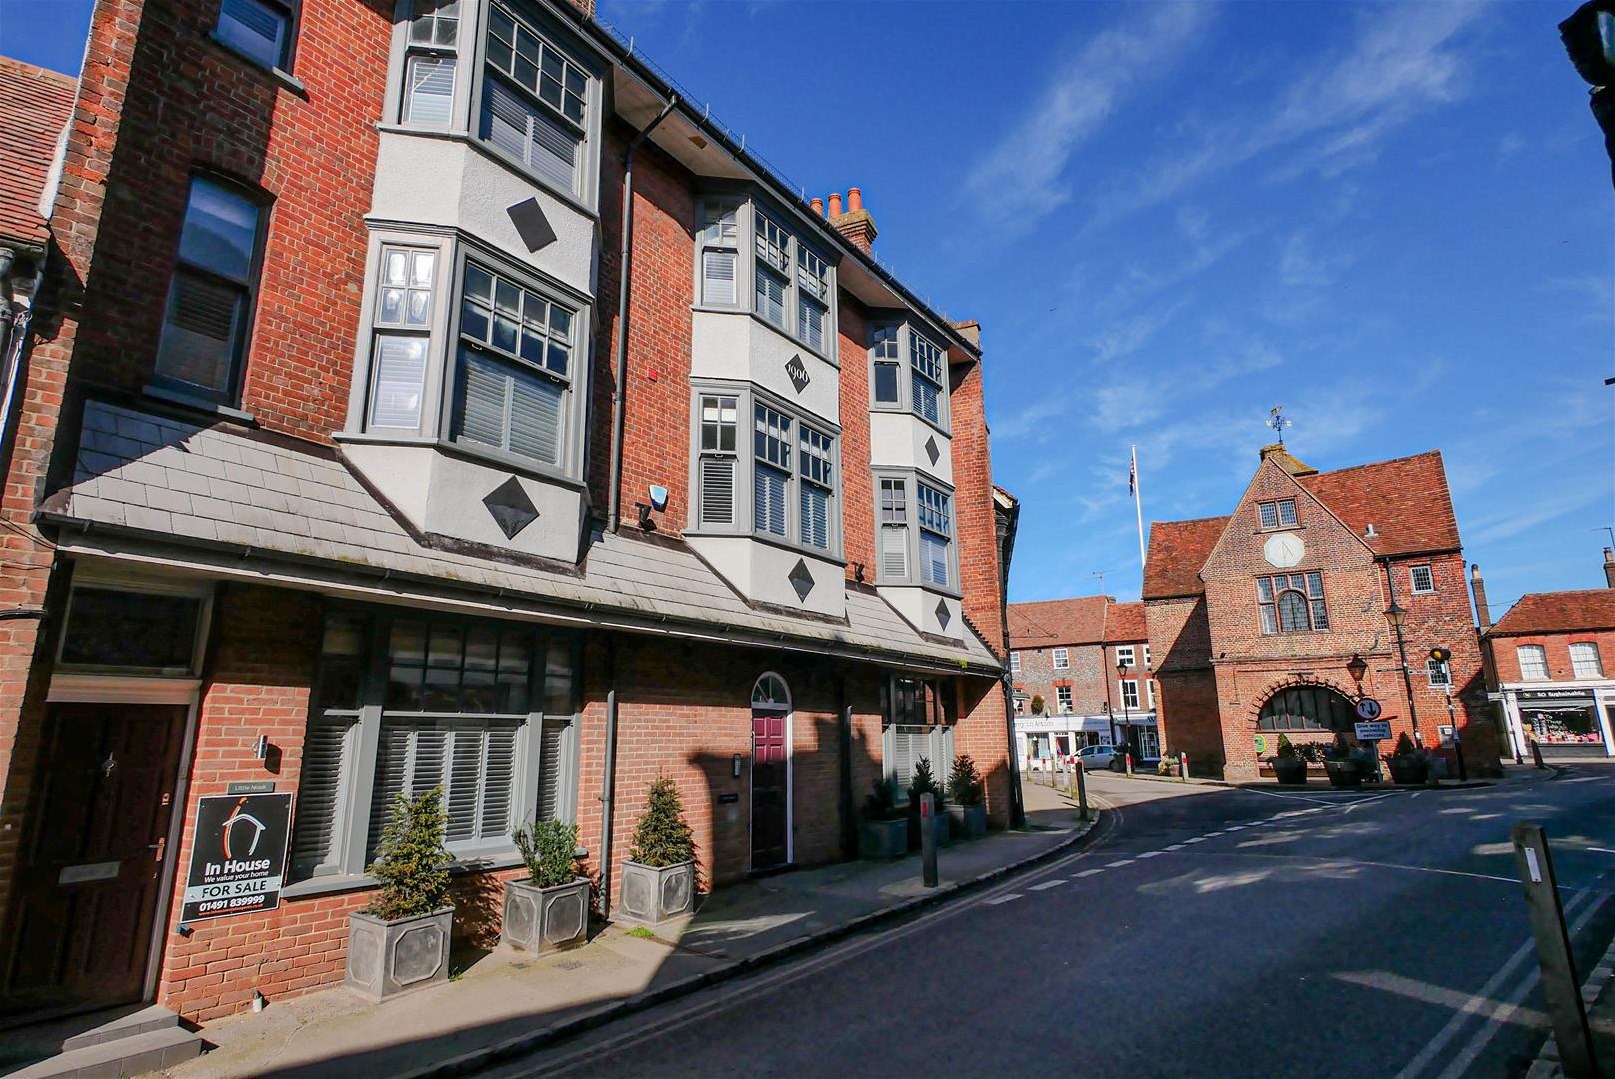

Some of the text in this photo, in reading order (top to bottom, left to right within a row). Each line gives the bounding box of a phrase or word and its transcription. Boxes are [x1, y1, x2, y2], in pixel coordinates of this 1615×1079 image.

[788, 364, 808, 382] 1906
[205, 859, 271, 876] In House
[217, 874, 234, 882] value
[235, 873, 250, 881] your
[202, 880, 267, 898] FOR SALE
[199, 894, 265, 912] 01491 839999
